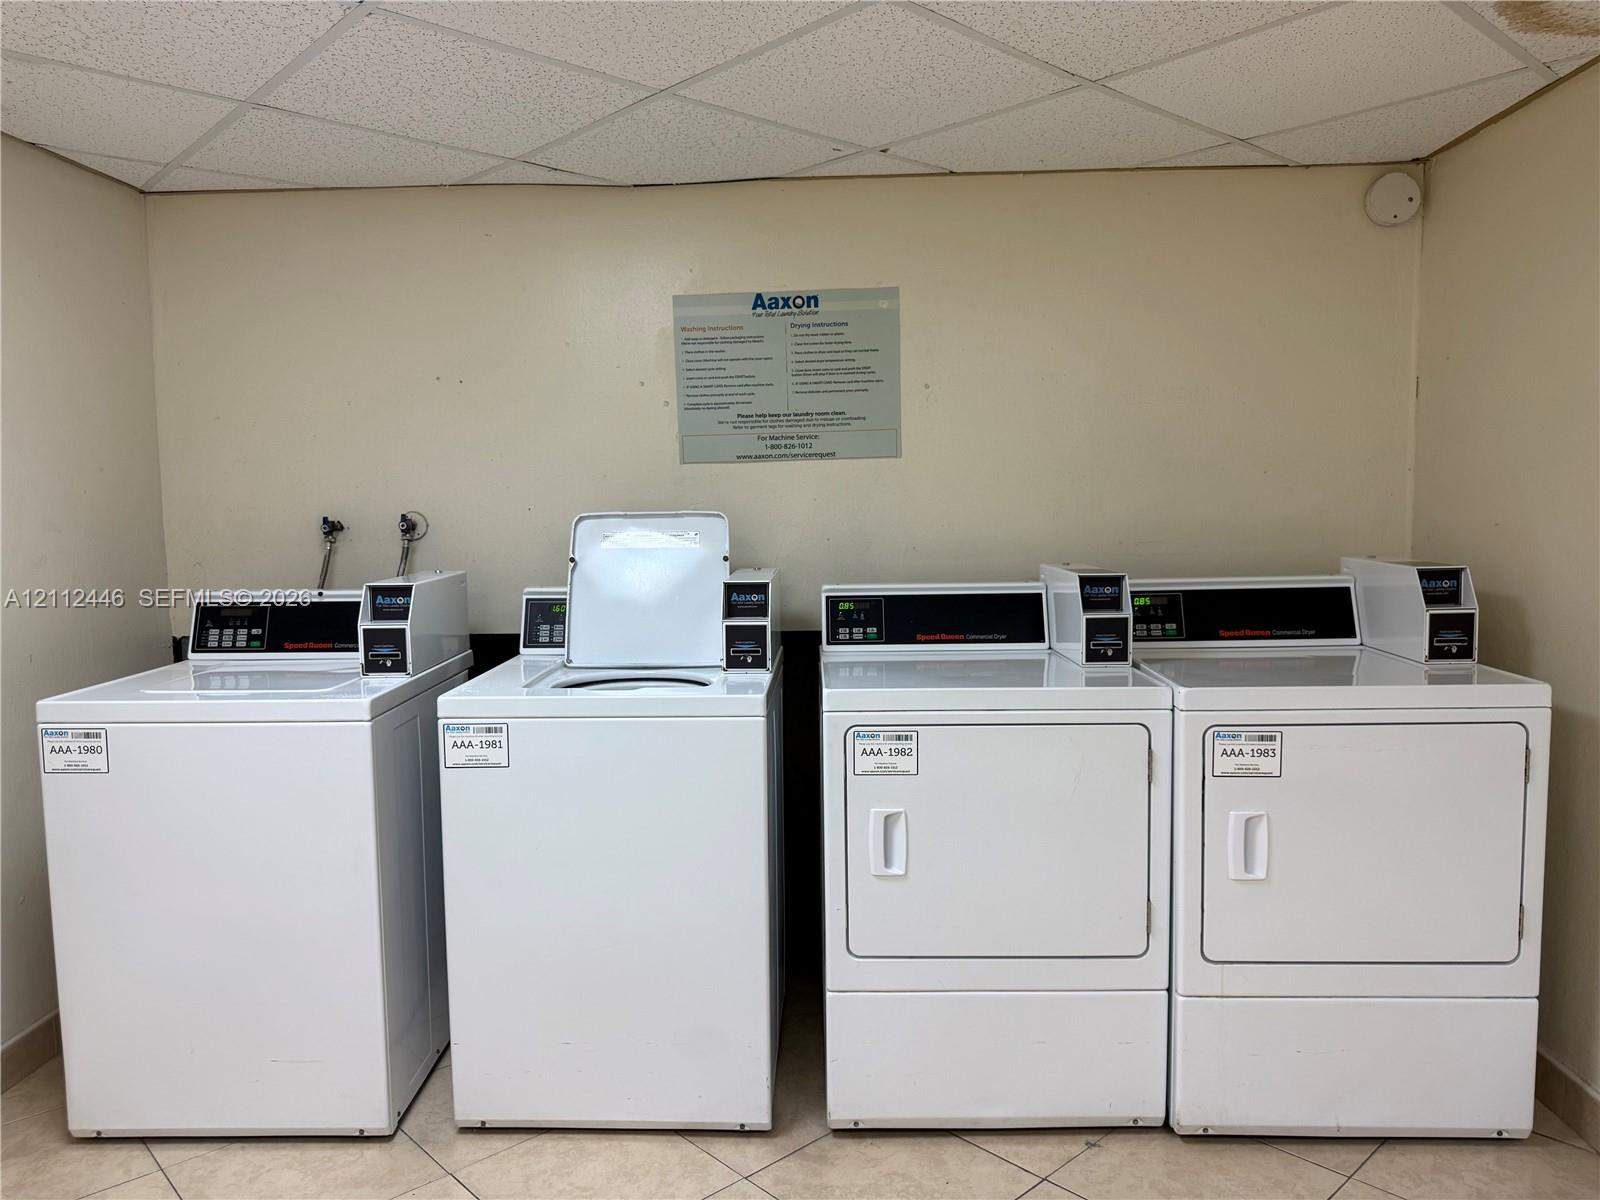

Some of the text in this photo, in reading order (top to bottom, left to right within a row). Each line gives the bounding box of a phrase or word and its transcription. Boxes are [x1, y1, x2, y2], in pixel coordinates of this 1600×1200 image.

[752, 293, 819, 310] Aaxon
[769, 433, 795, 441] Machine
[736, 450, 836, 460] www.aaxon.com/servicerequest
[1421, 579, 1457, 588] Aaxon
[1083, 585, 1119, 594] Aaxon
[376, 595, 411, 605] Aaxon
[731, 592, 765, 602] Aaxon
[916, 633, 940, 641] Speed
[1219, 629, 1244, 638] Speed
[451, 740, 503, 749] AAA-1981
[49, 745, 103, 755] AAA-1980
[860, 747, 913, 757] AAA-1982
[1220, 748, 1276, 758] AAA-1983
